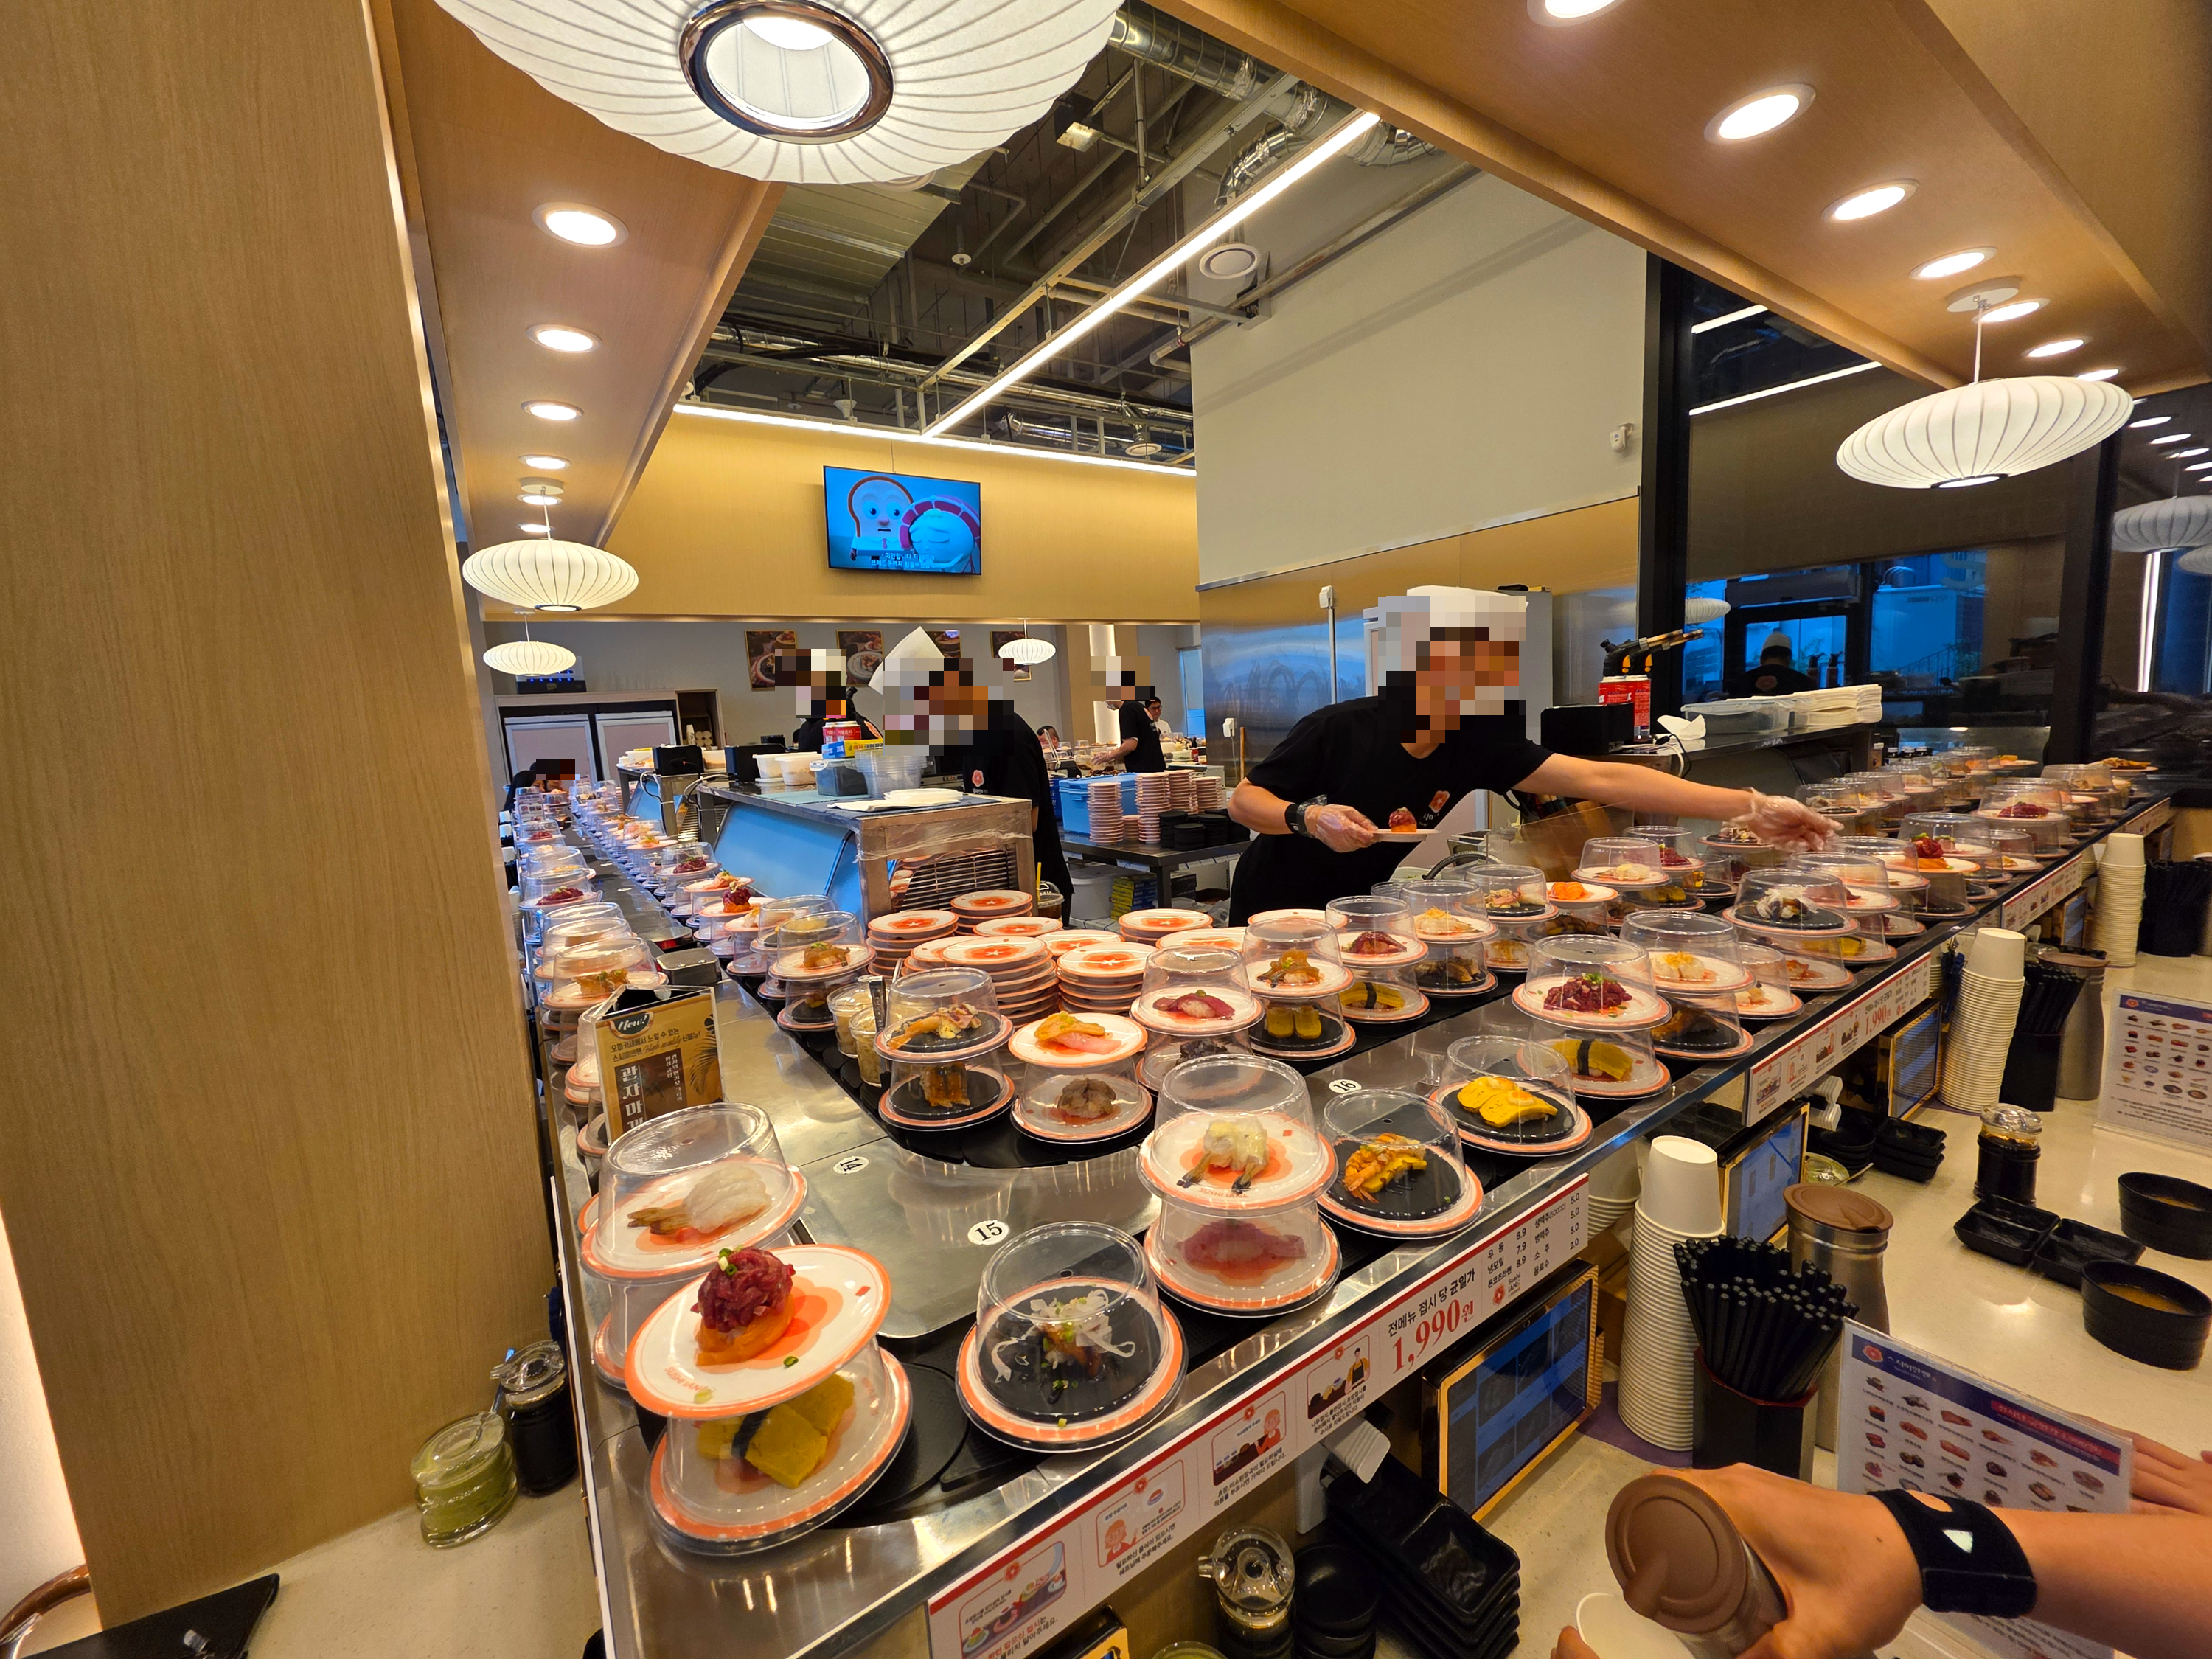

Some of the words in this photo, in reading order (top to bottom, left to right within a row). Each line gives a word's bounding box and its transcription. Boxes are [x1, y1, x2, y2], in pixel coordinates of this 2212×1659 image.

[617, 1015, 647, 1031] New!
[611, 1036, 647, 1052] 오마카세에서
[1333, 1081, 1357, 1091] 16
[839, 1157, 863, 1172] 14
[1199, 1188, 1224, 1197] SUSHI
[1570, 1192, 1580, 1205] 5.0
[974, 1222, 1003, 1242] 15
[1534, 1227, 1550, 1244] 병맥주
[1570, 1207, 1580, 1220] 5.0
[1570, 1222, 1579, 1235] 5.0
[1516, 1228, 1526, 1240] 6.9
[1487, 1256, 1504, 1275] 냉모밀
[1516, 1241, 1526, 1255] 7.9
[1516, 1255, 1526, 1268] 8.9
[1534, 1259, 1550, 1276] 음료수
[1569, 1237, 1579, 1251] 2.0
[1508, 1271, 1521, 1285] Sushi
[1388, 1311, 1417, 1338] 전메뉴
[1419, 1293, 1436, 1317] 접시
[1439, 1286, 1448, 1303] 당
[1450, 1268, 1475, 1296] 균일가
[1392, 1299, 1475, 1374] 1,990원
[664, 1366, 686, 1385] SUSHI
